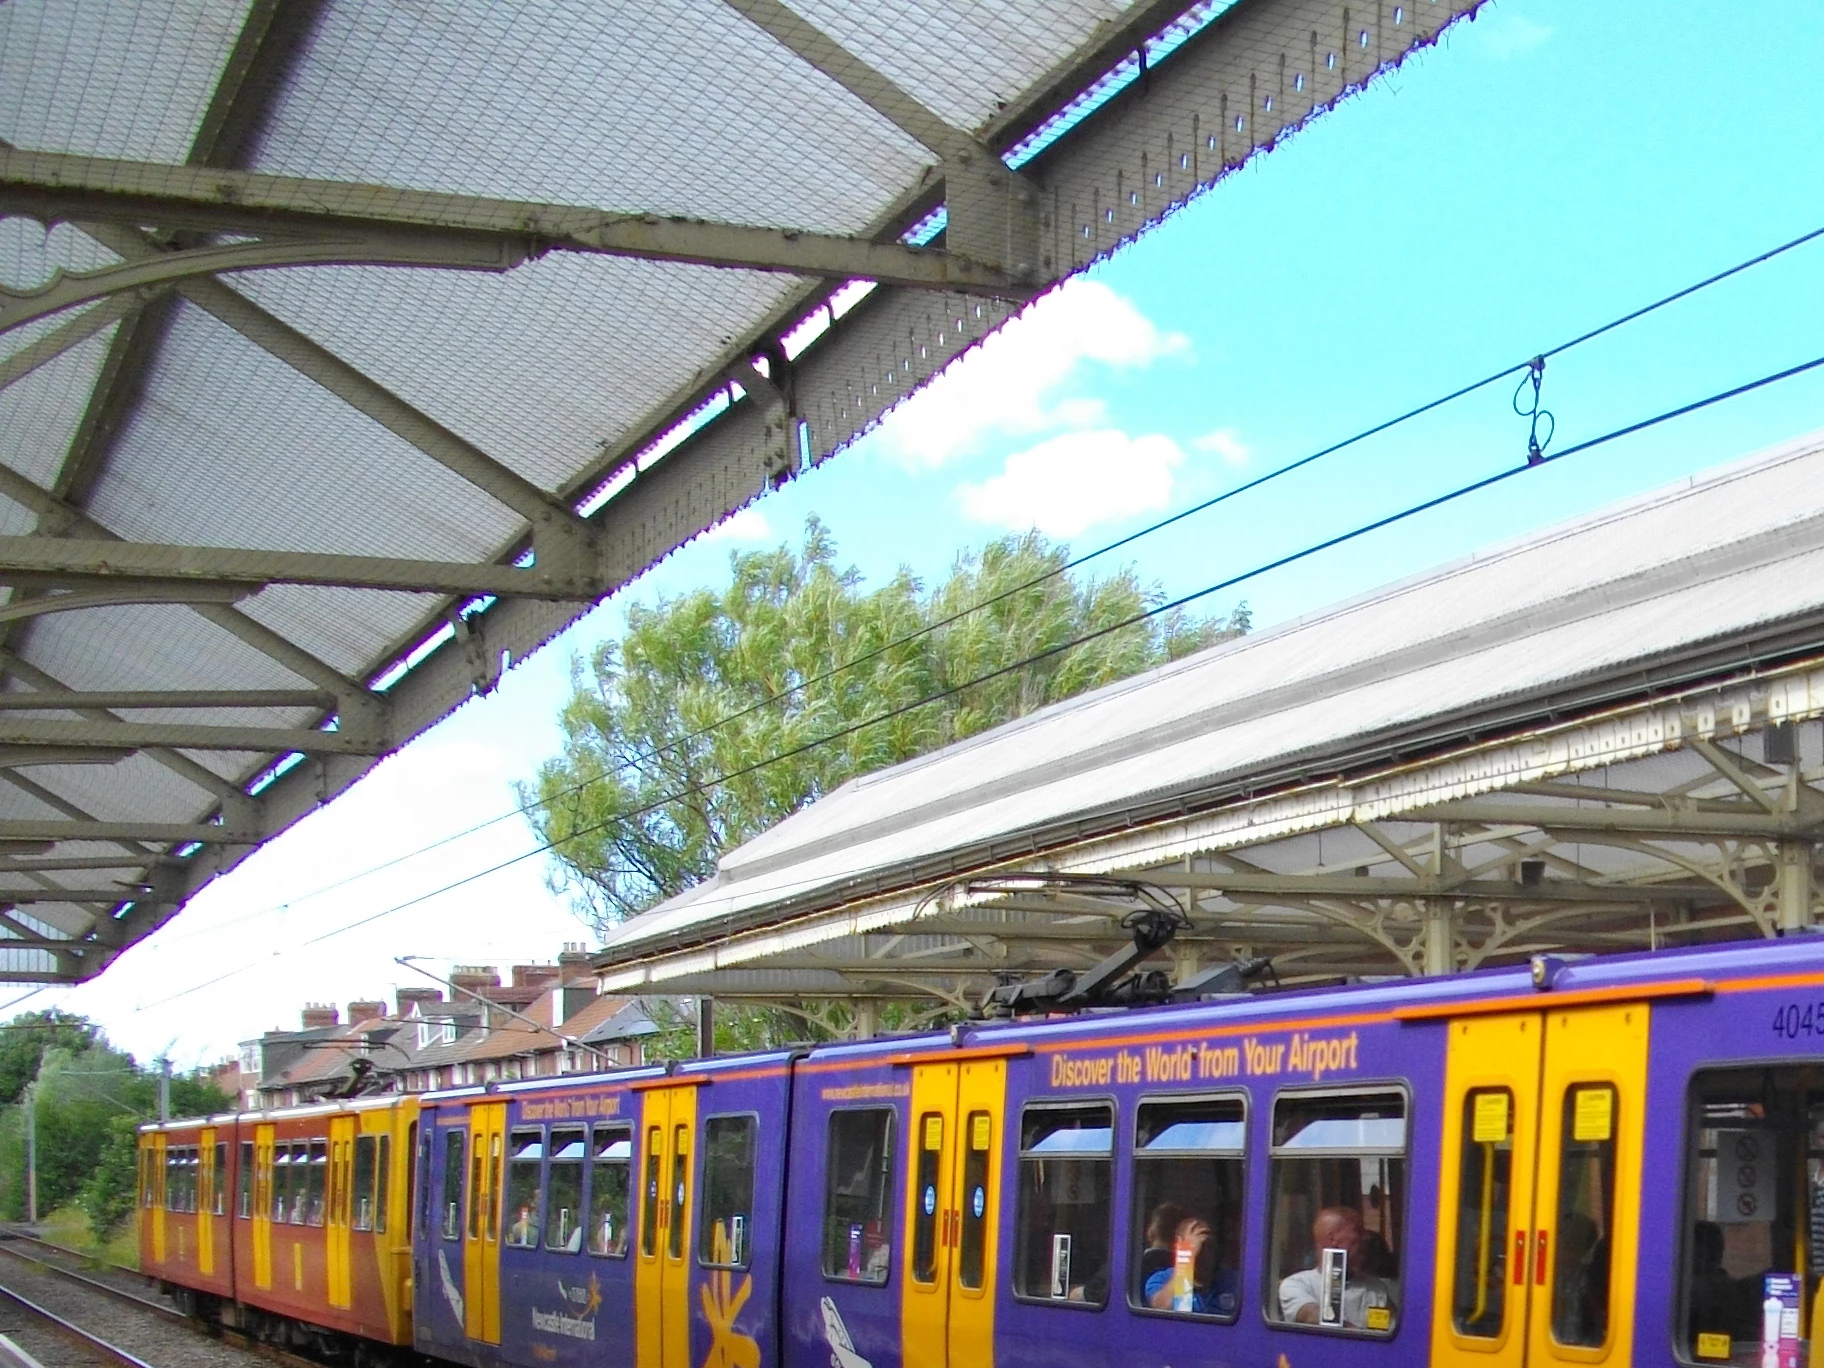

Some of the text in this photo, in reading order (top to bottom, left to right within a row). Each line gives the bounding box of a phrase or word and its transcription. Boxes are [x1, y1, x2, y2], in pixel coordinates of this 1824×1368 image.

[1051, 1031, 1358, 1087] Discover the World from Your Airport
